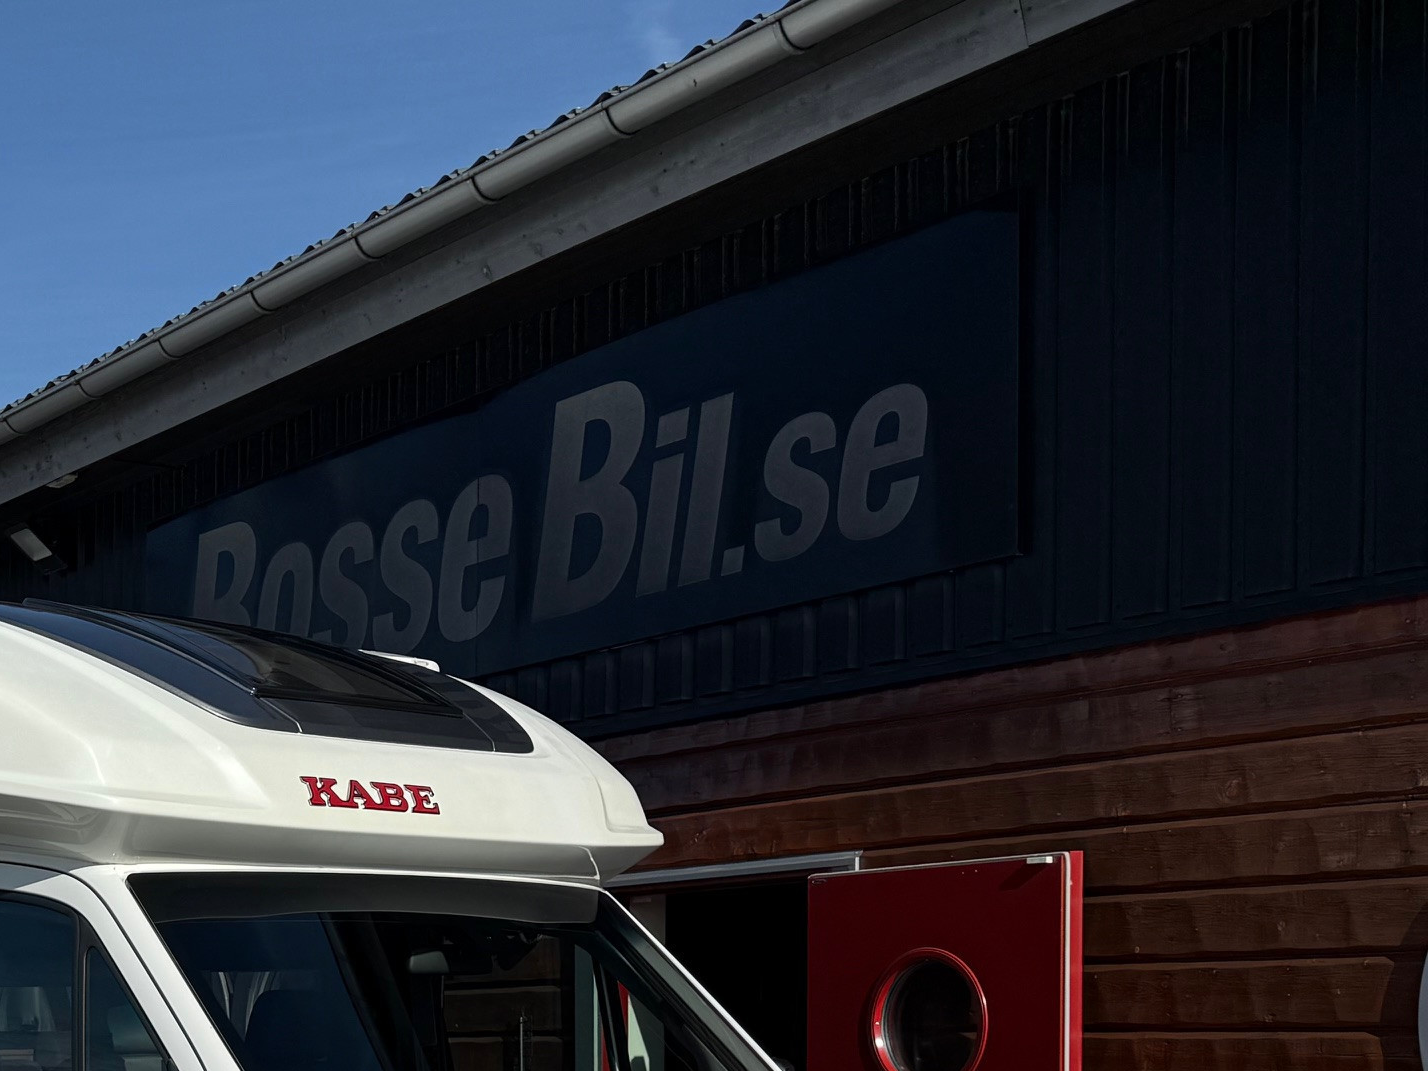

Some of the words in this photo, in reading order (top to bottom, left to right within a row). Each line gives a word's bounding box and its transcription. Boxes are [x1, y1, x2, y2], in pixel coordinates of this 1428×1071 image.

[192, 474, 513, 656] Bosse
[531, 379, 929, 622] Bil.se
[299, 775, 441, 815] KABE
